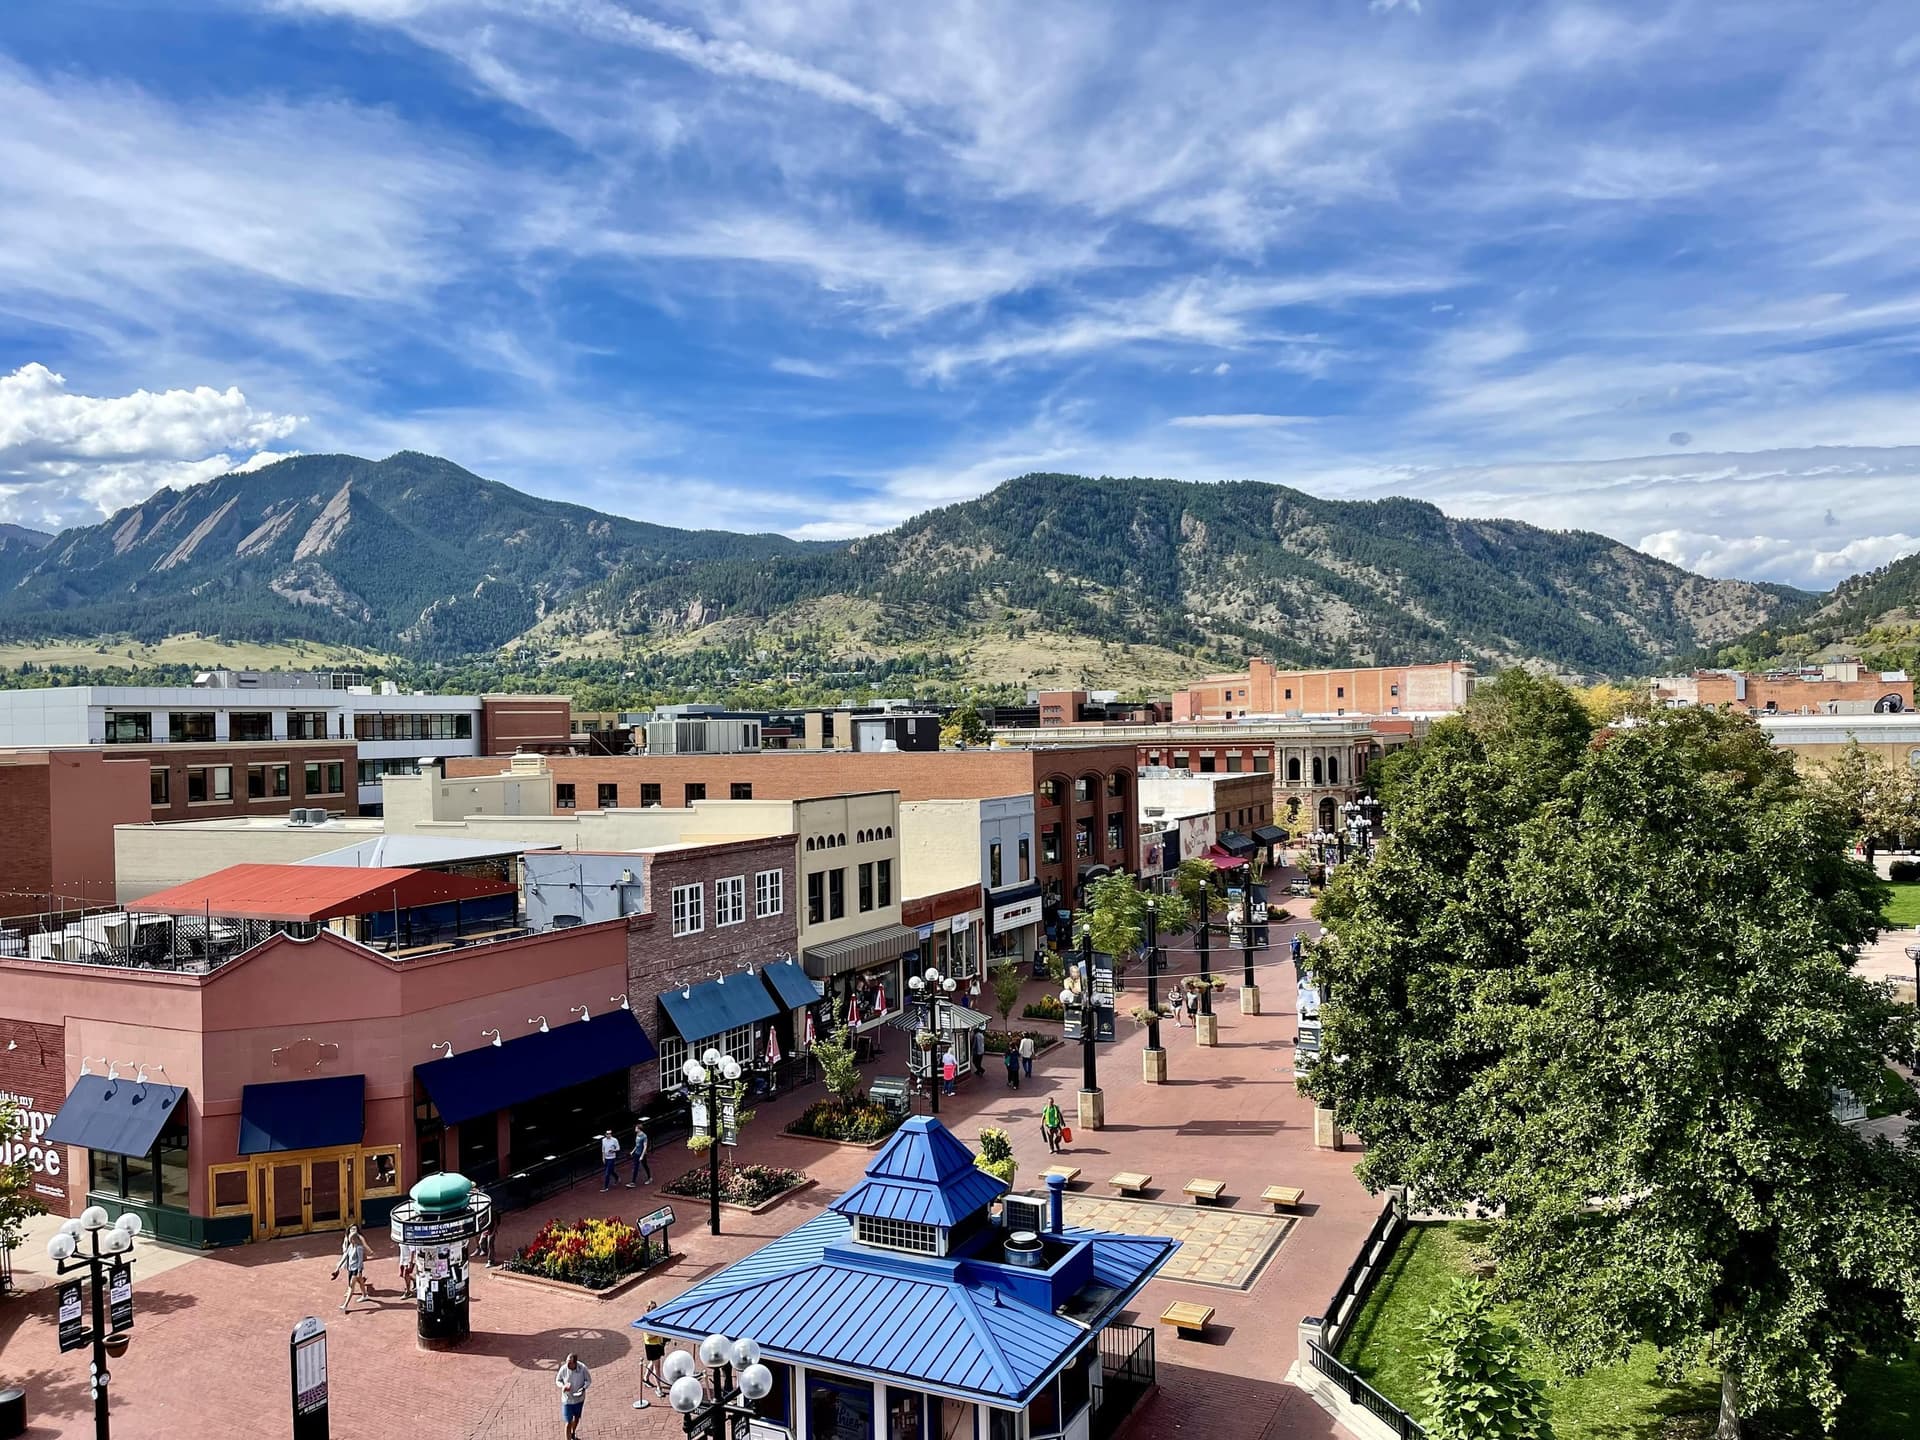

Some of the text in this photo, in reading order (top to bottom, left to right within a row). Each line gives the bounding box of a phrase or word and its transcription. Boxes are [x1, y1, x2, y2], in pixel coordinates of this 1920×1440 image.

[19, 1095, 34, 1109] my
[723, 1105, 734, 1116] 40
[0, 1136, 60, 1176] lace
